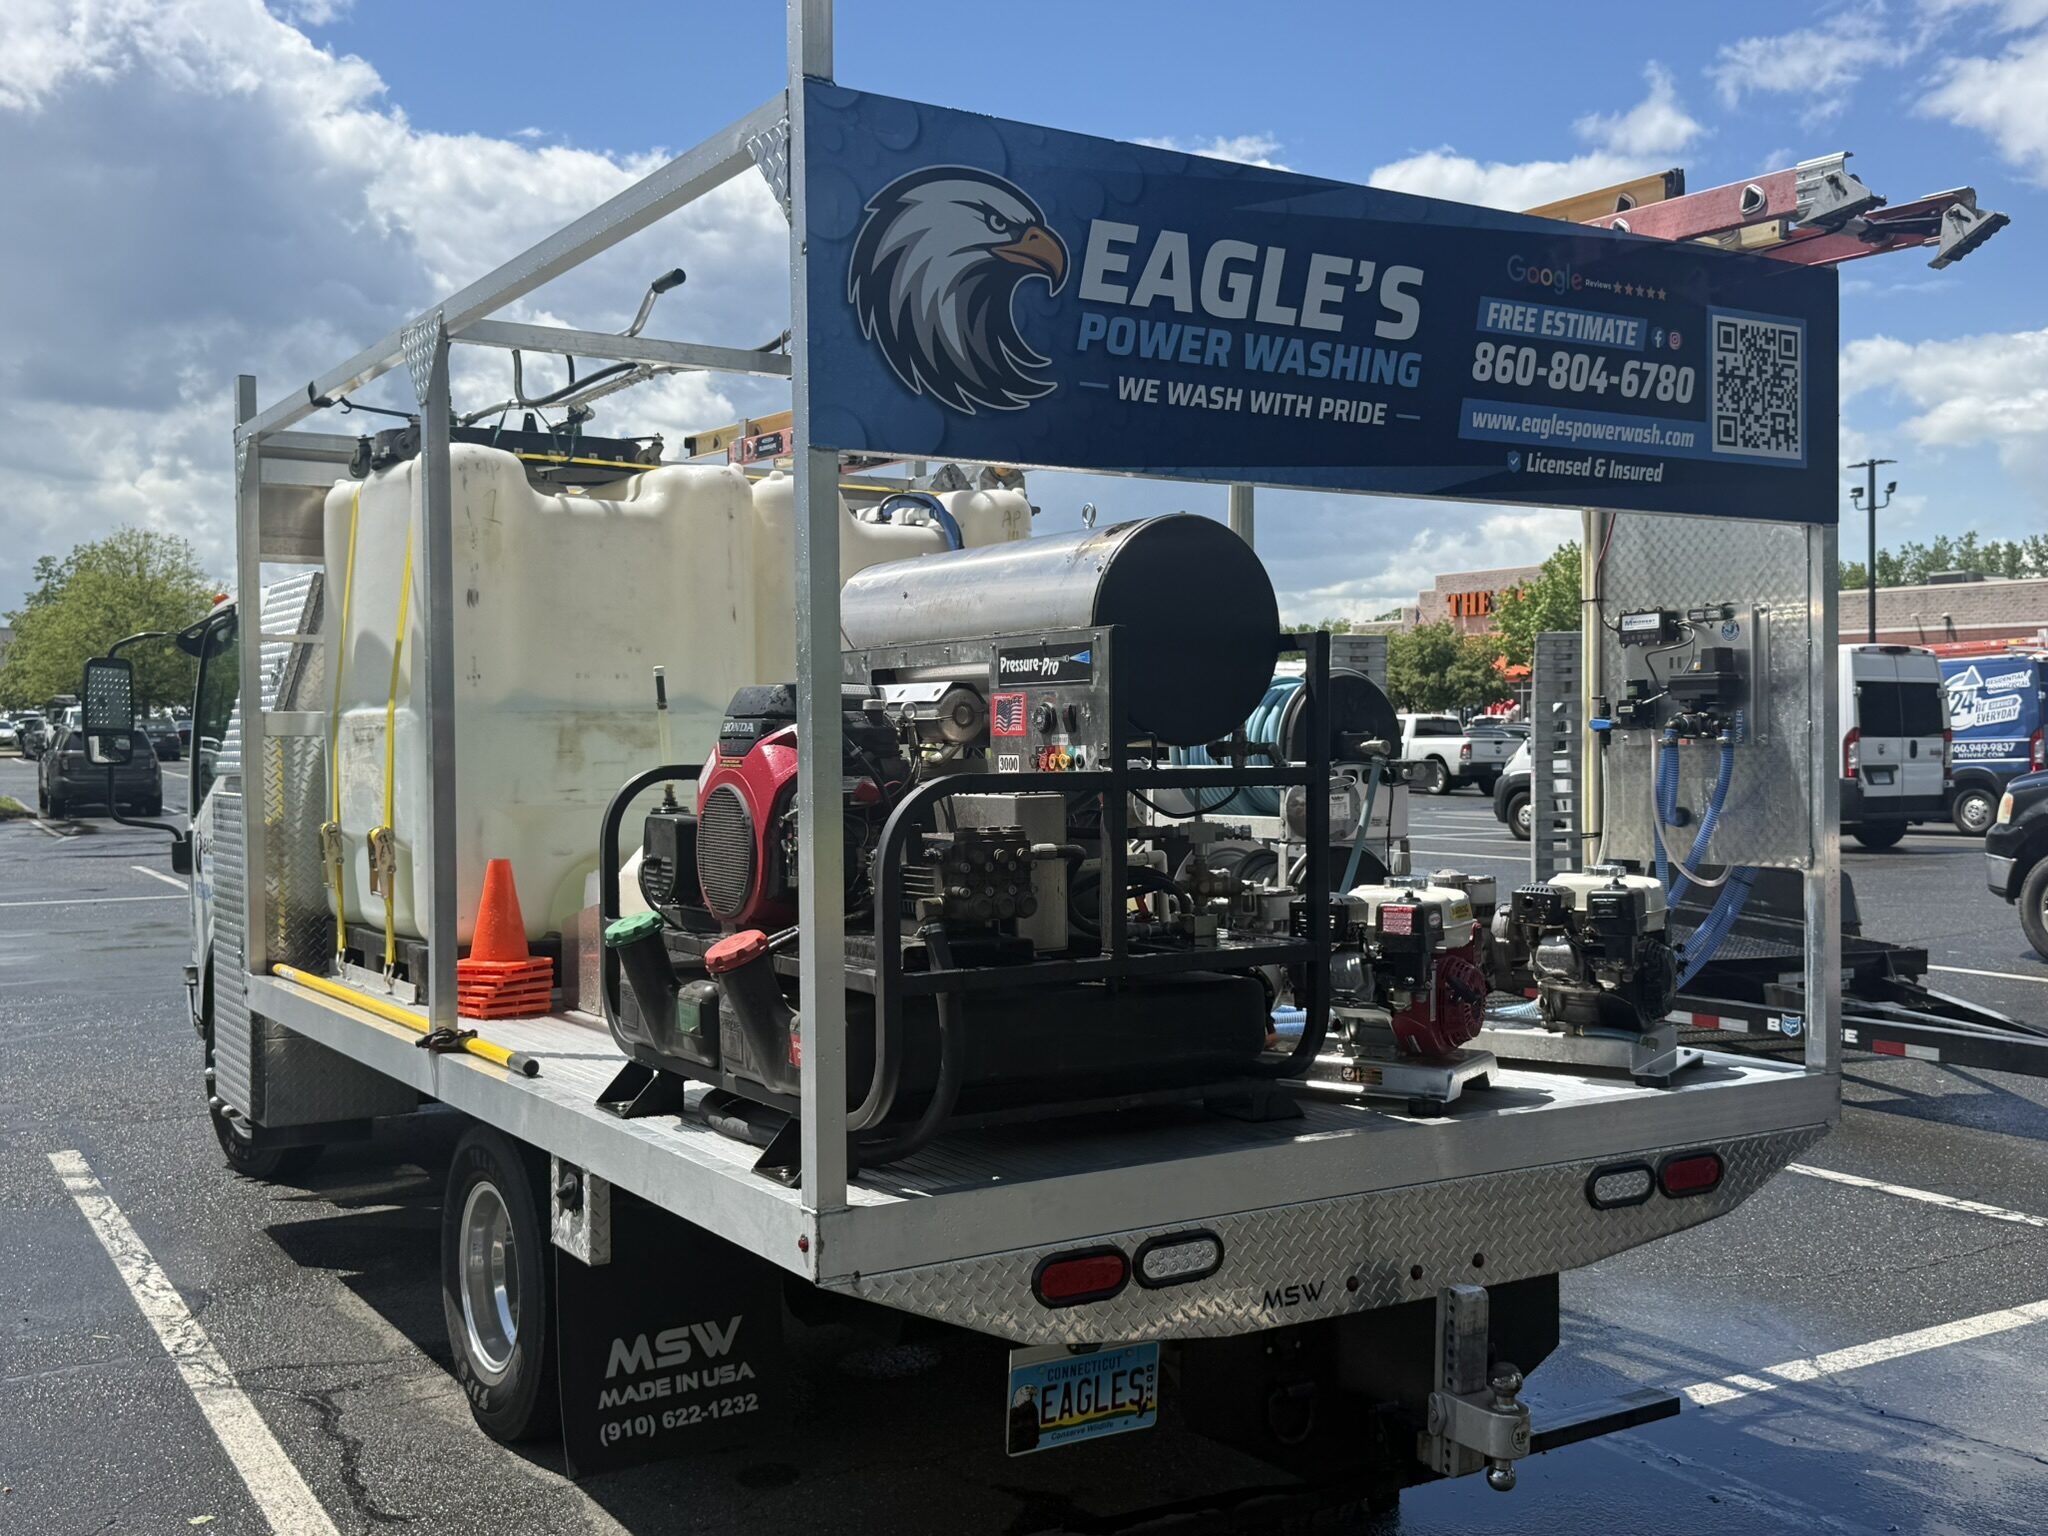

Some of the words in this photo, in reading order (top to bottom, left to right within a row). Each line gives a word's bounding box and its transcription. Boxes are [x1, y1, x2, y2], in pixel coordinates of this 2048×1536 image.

[1077, 219, 1425, 340] EAGLE'S
[1507, 254, 1583, 295] Google
[1585, 278, 1612, 291] Reviews
[1486, 302, 1537, 334] FREE
[1540, 313, 1639, 347] ESTIMATE
[1077, 312, 1232, 368] POWER
[1244, 336, 1423, 389] WASHING
[1472, 340, 1696, 404] 860-804-6780
[1118, 375, 1160, 402] WE
[1167, 379, 1244, 410] WASH
[1249, 390, 1314, 418] WITH
[1318, 397, 1388, 426] PRIDE
[1472, 409, 1695, 449] www.eaglespowerwash.com
[1526, 452, 1591, 478] Licensed
[1594, 458, 1607, 478] &
[1609, 459, 1664, 483] Insured
[1446, 591, 1494, 617] THE
[1000, 656, 1060, 676] Pressure-Pro
[1950, 690, 1975, 717] 24
[1976, 707, 2018, 724] EVERYDAY
[722, 722, 755, 733] HONDA
[1735, 709, 1745, 744] WATER
[999, 757, 1018, 771] 3000
[1262, 1280, 1326, 1311] MSW
[605, 1315, 743, 1379] MSW
[598, 1376, 672, 1411] MADE
[675, 1371, 699, 1394] IN
[702, 1361, 756, 1388] USA
[1047, 1355, 1122, 1382] CONNECTICUT
[1040, 1366, 1145, 1425] EAGLES
[600, 1415, 656, 1447] (910)
[662, 1392, 759, 1430] 622-1232
[1051, 1428, 1086, 1441] Conserve
[1087, 1420, 1115, 1435] Wildlife
